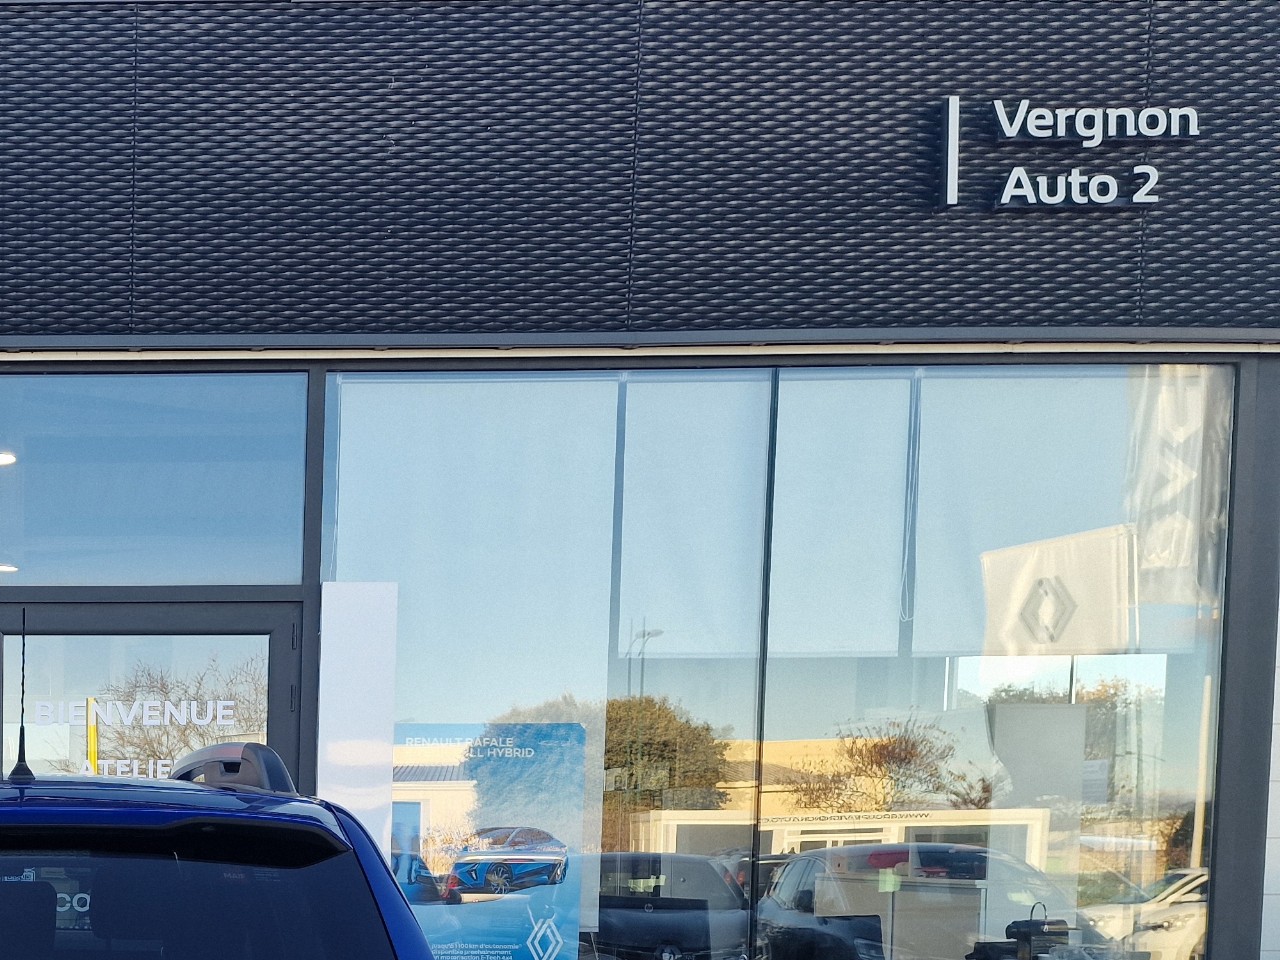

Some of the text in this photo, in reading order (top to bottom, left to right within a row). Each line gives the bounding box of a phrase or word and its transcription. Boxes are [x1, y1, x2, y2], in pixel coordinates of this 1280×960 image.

[993, 99, 1201, 148] Vergnon
[1000, 164, 1160, 205] Auto 2
[35, 700, 235, 726] BIENVENUE
[487, 748, 534, 758] HYBRID
[78, 758, 179, 779] ATELIE
